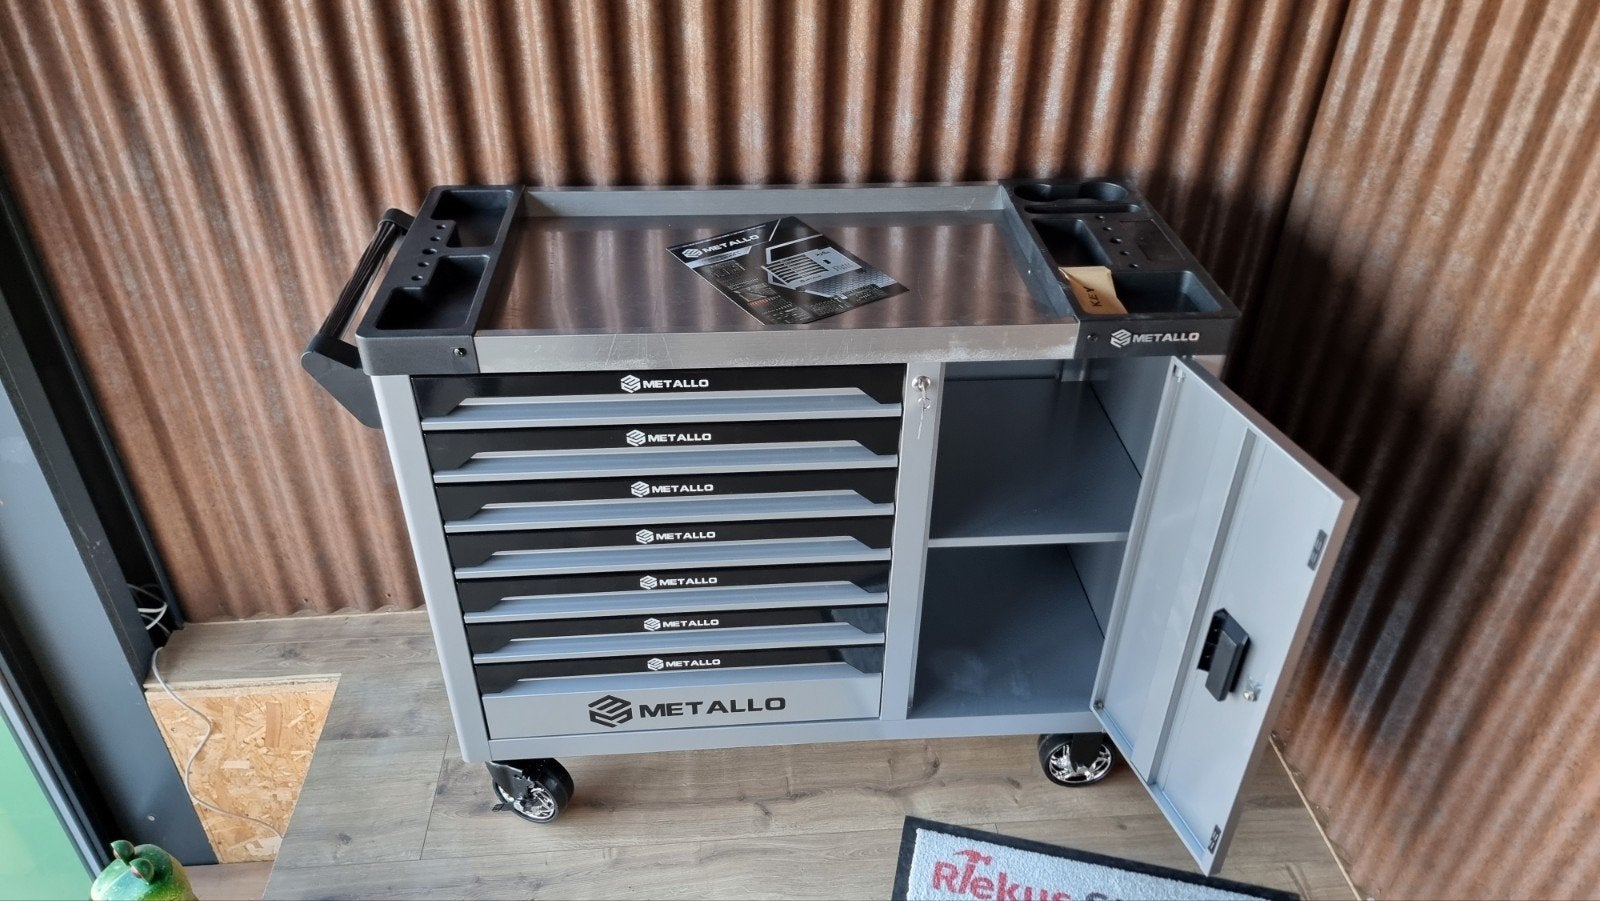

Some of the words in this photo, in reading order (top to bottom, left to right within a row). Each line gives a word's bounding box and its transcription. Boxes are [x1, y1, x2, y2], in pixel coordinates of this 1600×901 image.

[702, 234, 760, 253] METALLO
[1083, 286, 1102, 307] KEY
[1132, 332, 1200, 343] METALLO
[642, 379, 709, 388] METALLO
[647, 433, 712, 442] METALLO
[651, 484, 714, 494] METALLO
[655, 531, 716, 541] METALLO
[659, 577, 718, 586] METALLO
[662, 619, 719, 628] METALLO
[665, 658, 721, 668] METALLO
[639, 697, 786, 718] METALLO
